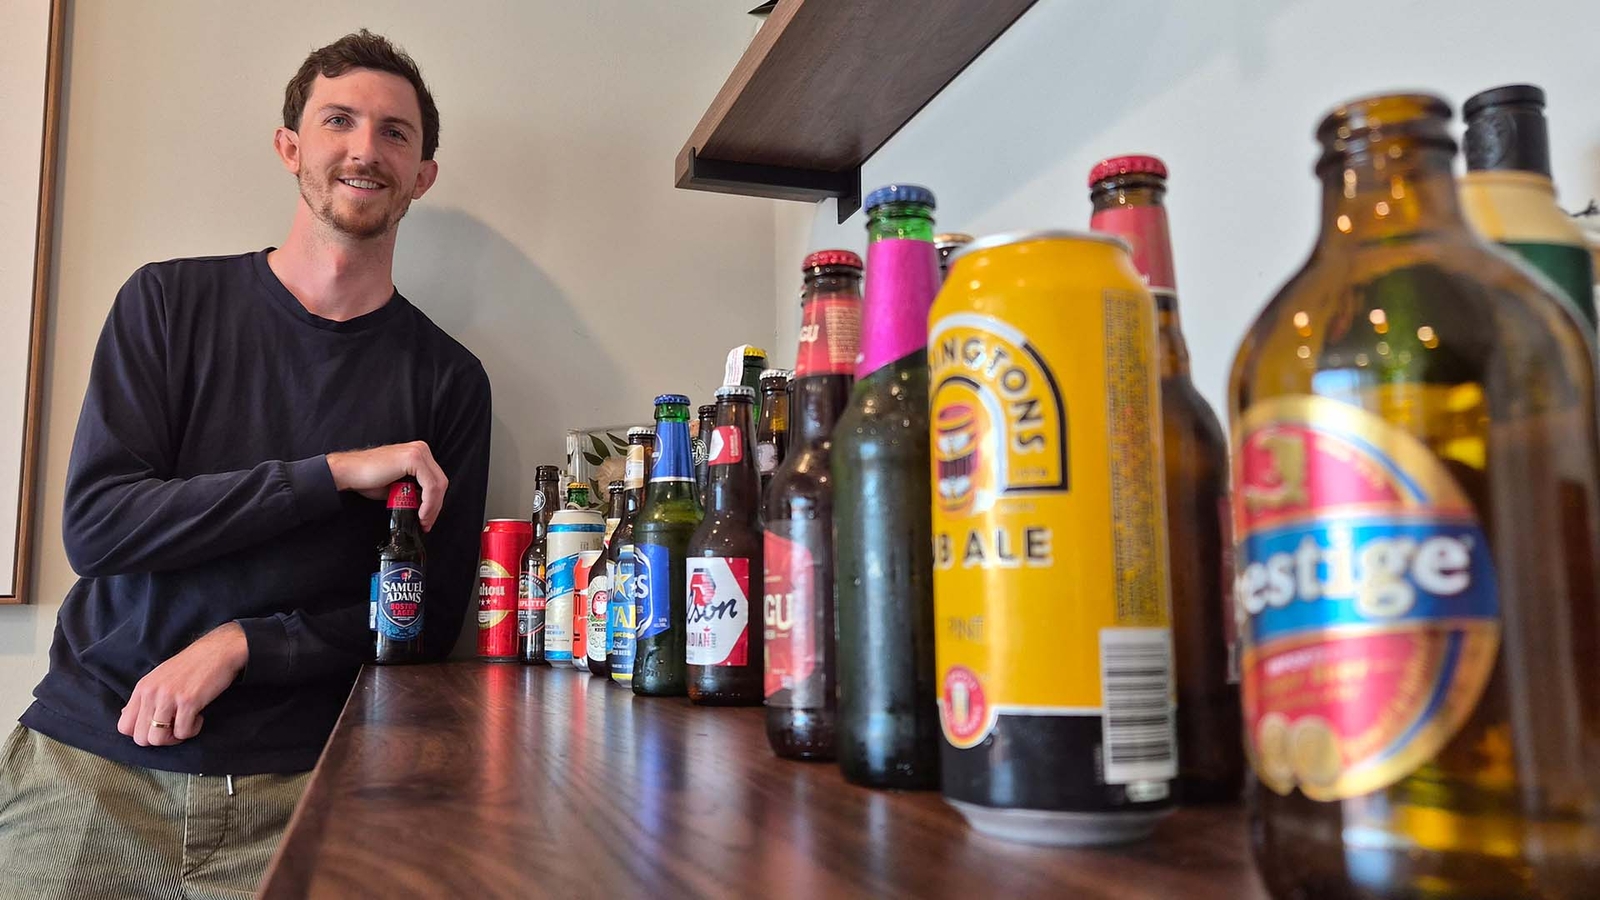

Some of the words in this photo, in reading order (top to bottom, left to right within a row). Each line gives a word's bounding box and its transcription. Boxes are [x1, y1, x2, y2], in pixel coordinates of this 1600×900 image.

[962, 526, 1053, 569] ALE
[382, 581, 424, 593] SAMUEL
[385, 592, 422, 604] ADAMS
